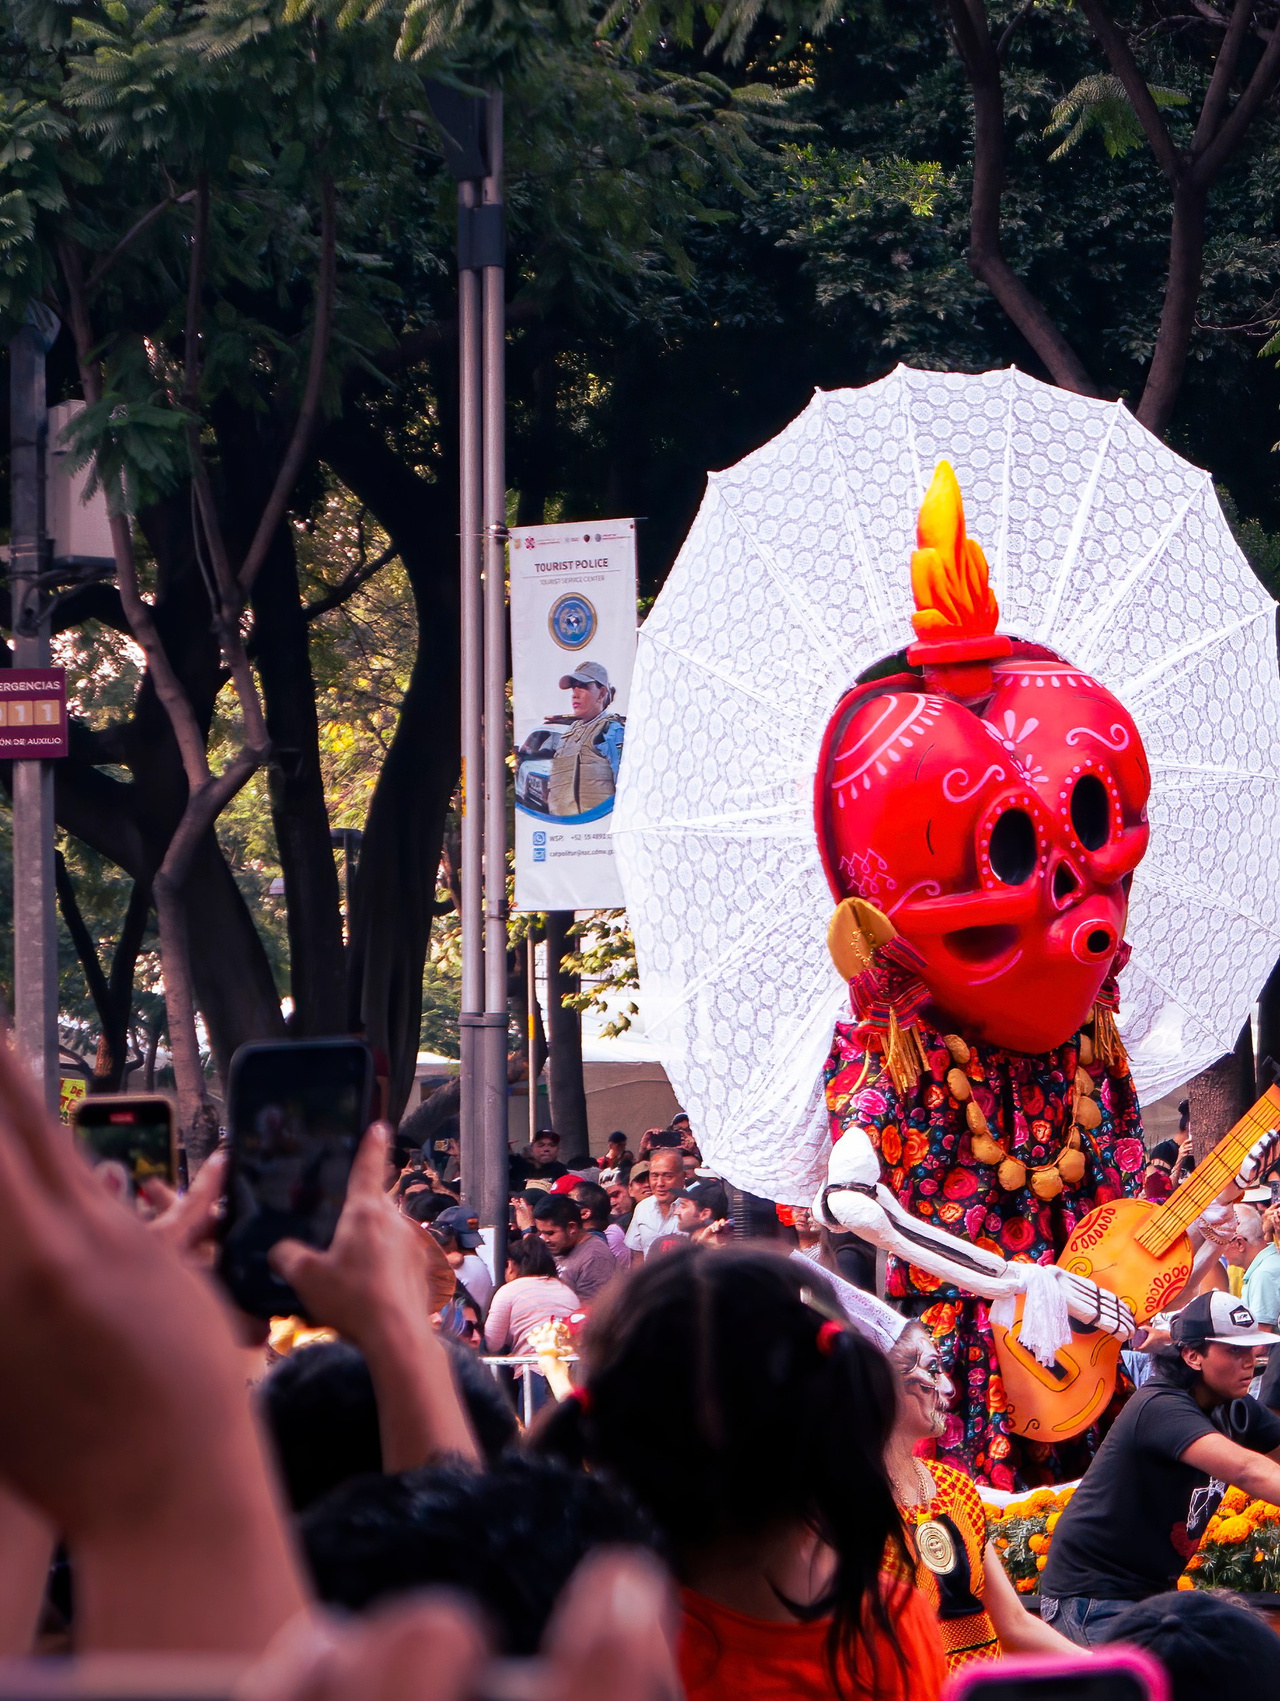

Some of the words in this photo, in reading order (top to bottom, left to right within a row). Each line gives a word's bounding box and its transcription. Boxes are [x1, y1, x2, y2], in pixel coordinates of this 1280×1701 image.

[535, 561, 573, 572] TOURIST
[575, 558, 608, 569] POLICE
[583, 575, 605, 583] CENTER
[0, 704, 51, 722] 11
[13, 738, 25, 746] DE
[27, 737, 61, 745] AUXILIO
